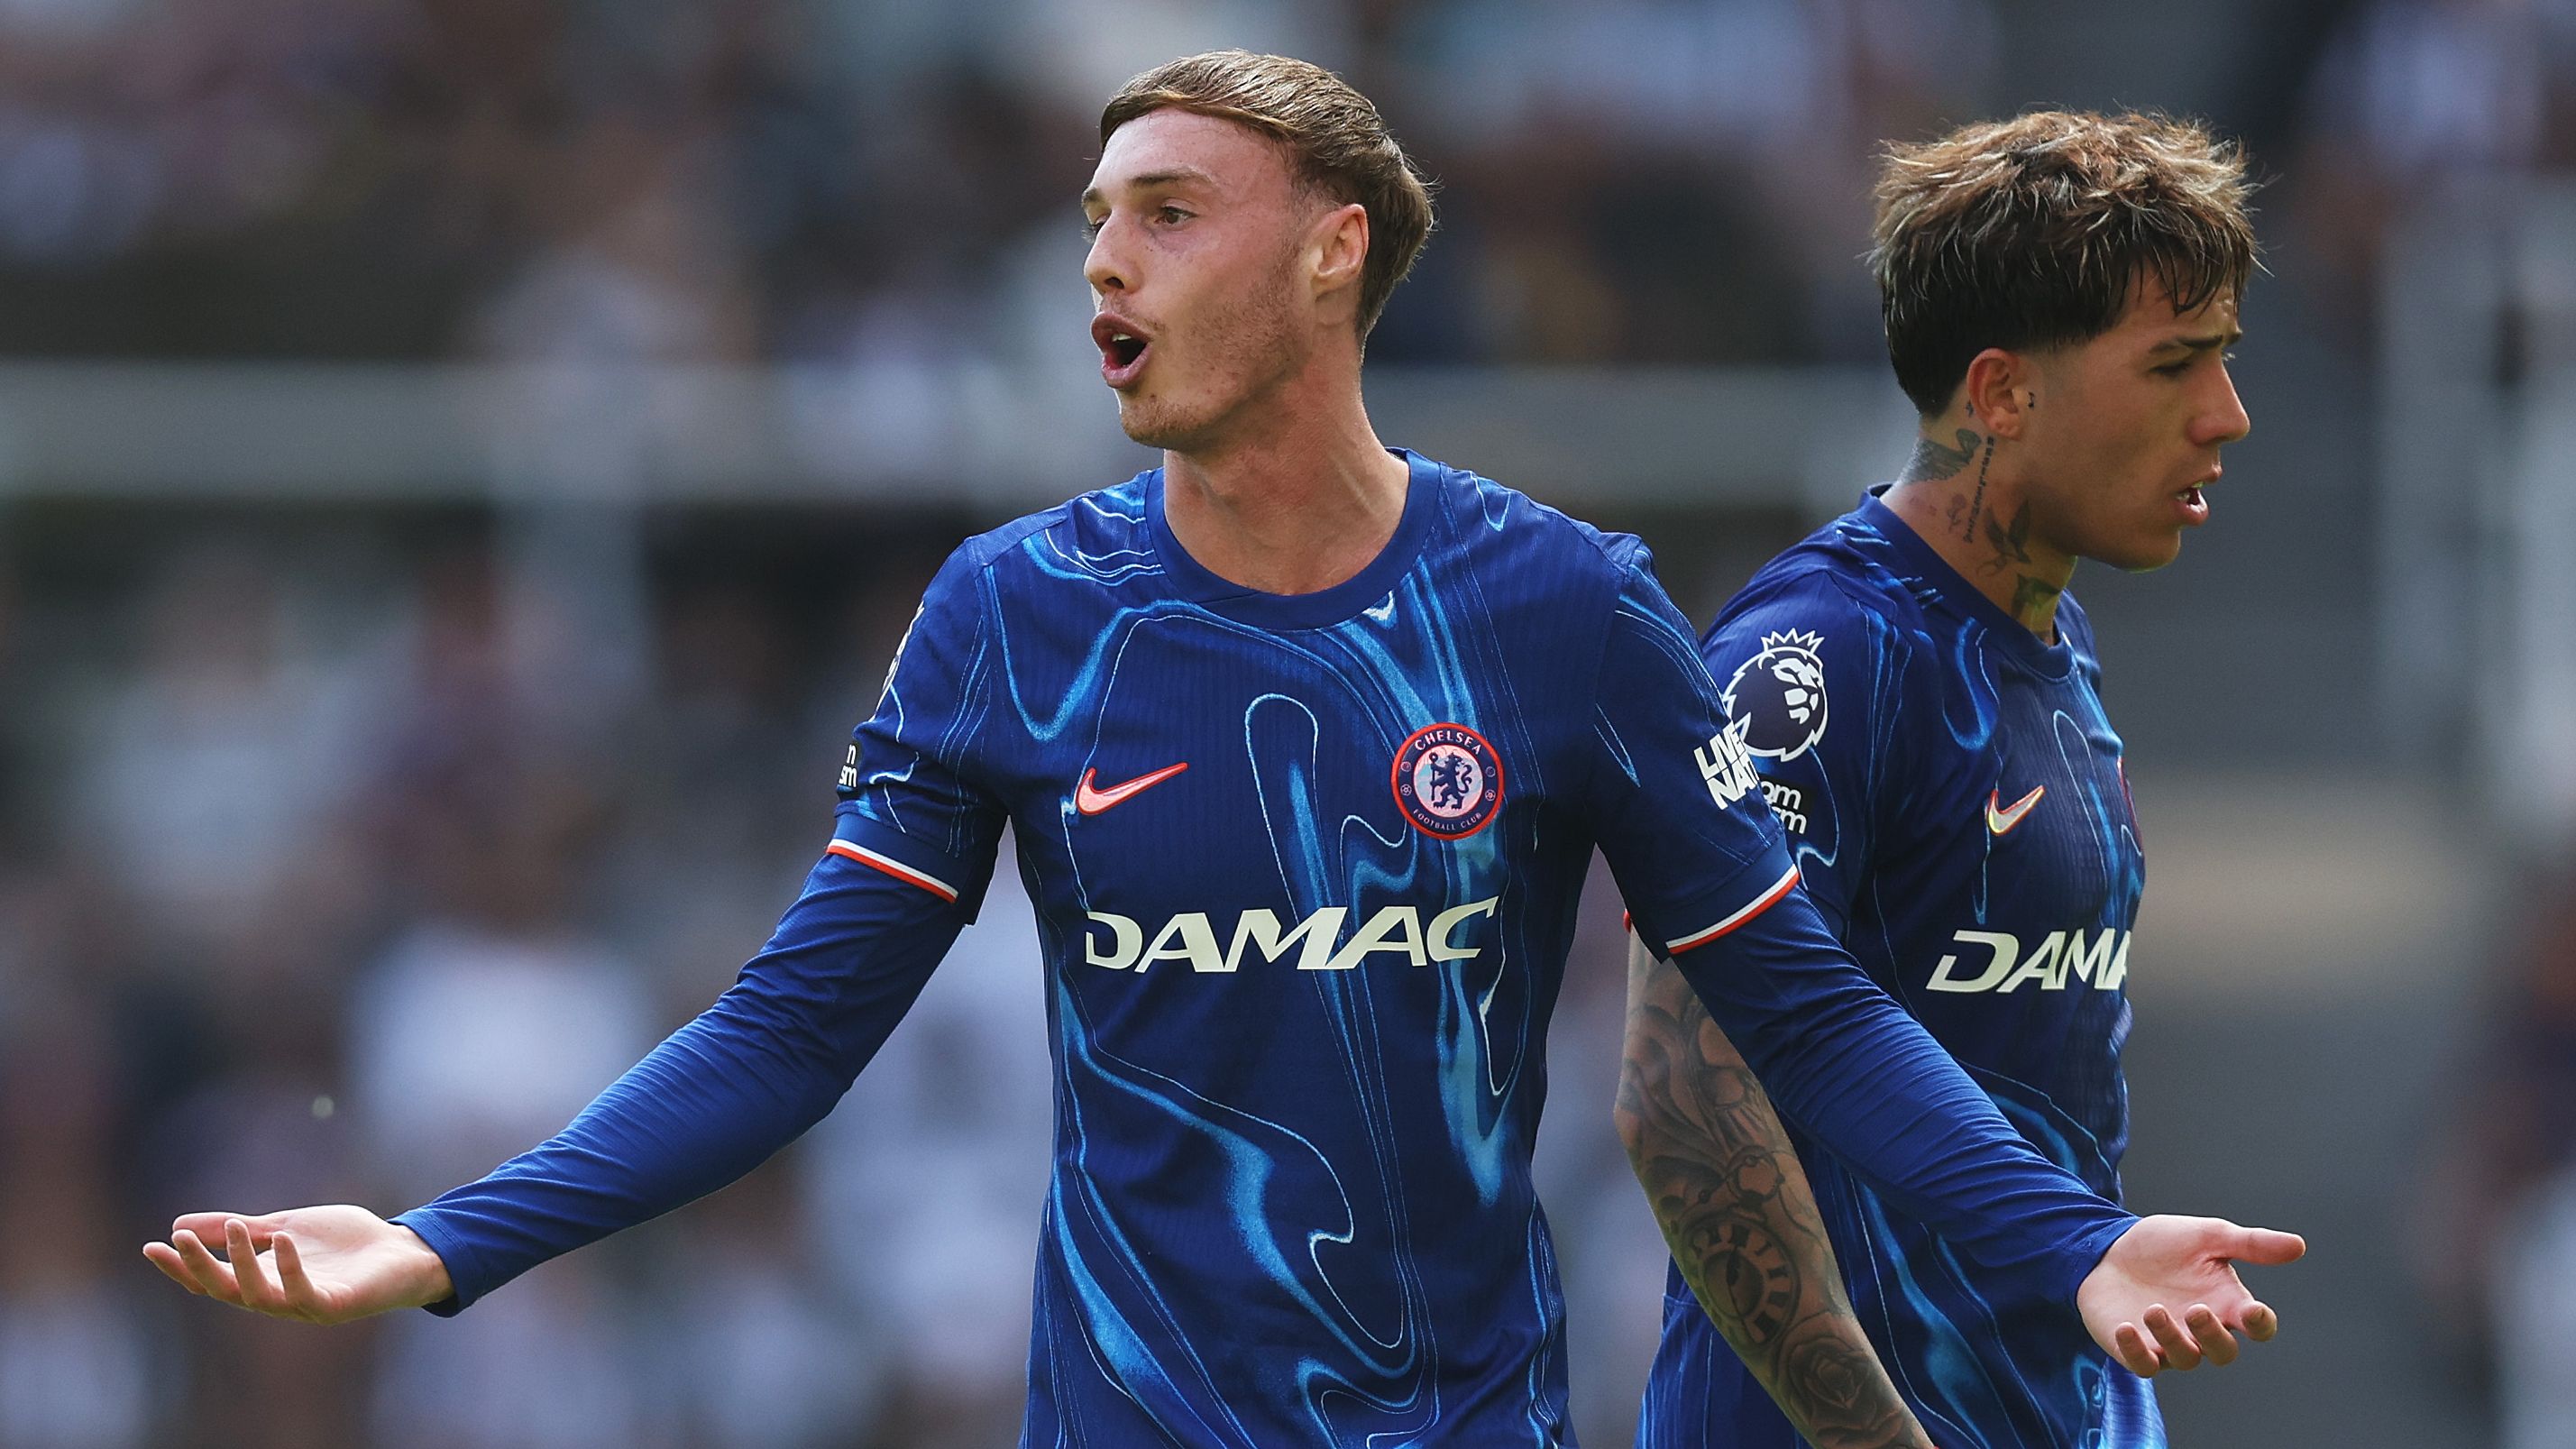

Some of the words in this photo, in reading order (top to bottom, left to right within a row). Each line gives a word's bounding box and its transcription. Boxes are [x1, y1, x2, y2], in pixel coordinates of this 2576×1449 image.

[1415, 729, 1481, 755] CHELSEA
[1693, 720, 1746, 781] LIVE
[1461, 812, 1482, 829] CLUB
[1085, 895, 1499, 974] DAMAC
